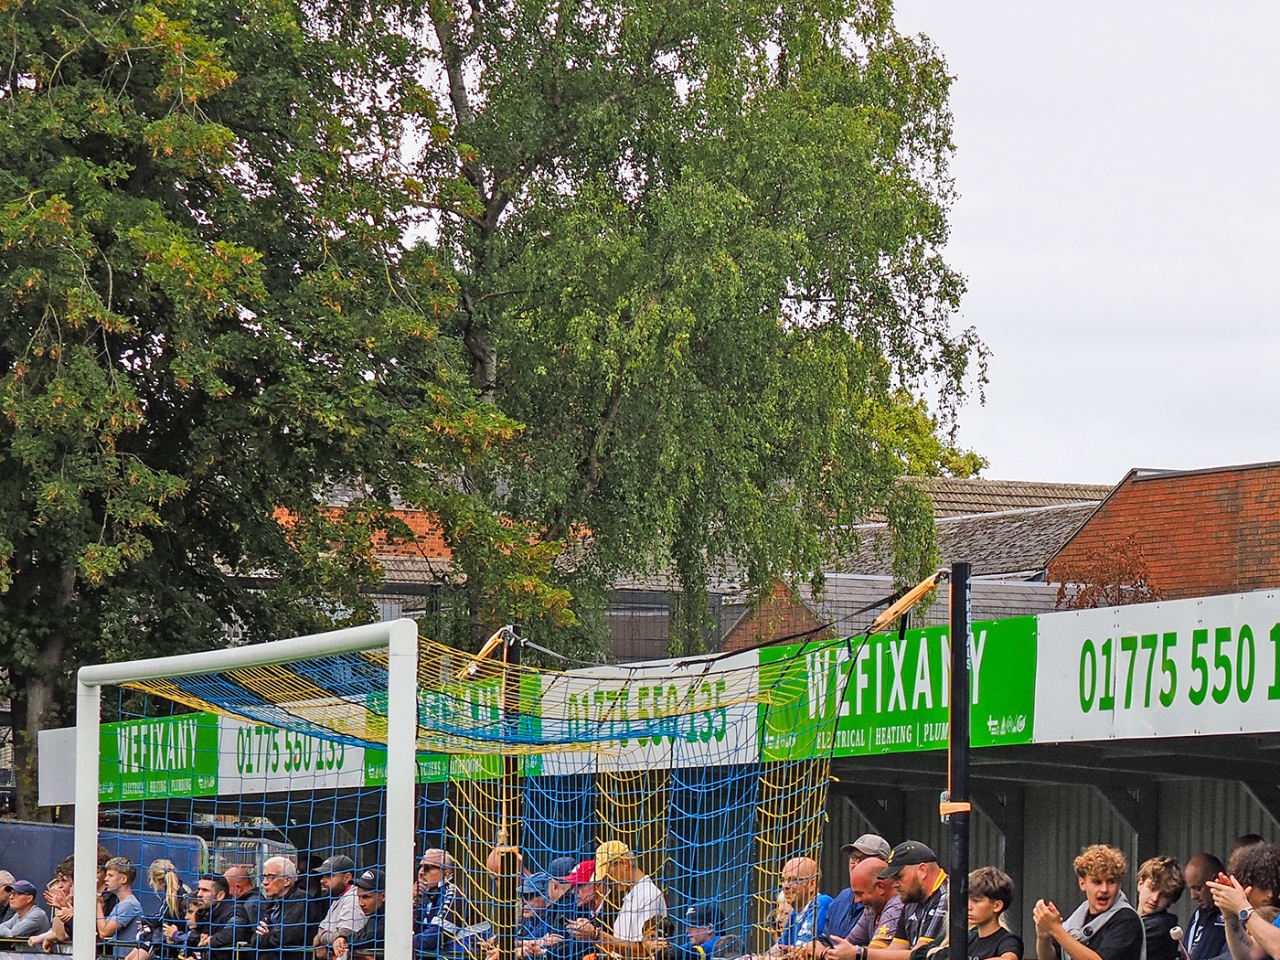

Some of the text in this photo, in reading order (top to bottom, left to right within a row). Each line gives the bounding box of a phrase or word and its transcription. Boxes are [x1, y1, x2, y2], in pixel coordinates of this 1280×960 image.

[1079, 631, 1177, 714] 01775
[1188, 624, 1255, 706] 550
[117, 719, 197, 773] WEFIXANY
[236, 726, 279, 774] 01775
[284, 731, 311, 773] 550
[876, 725, 912, 745] HEATING
